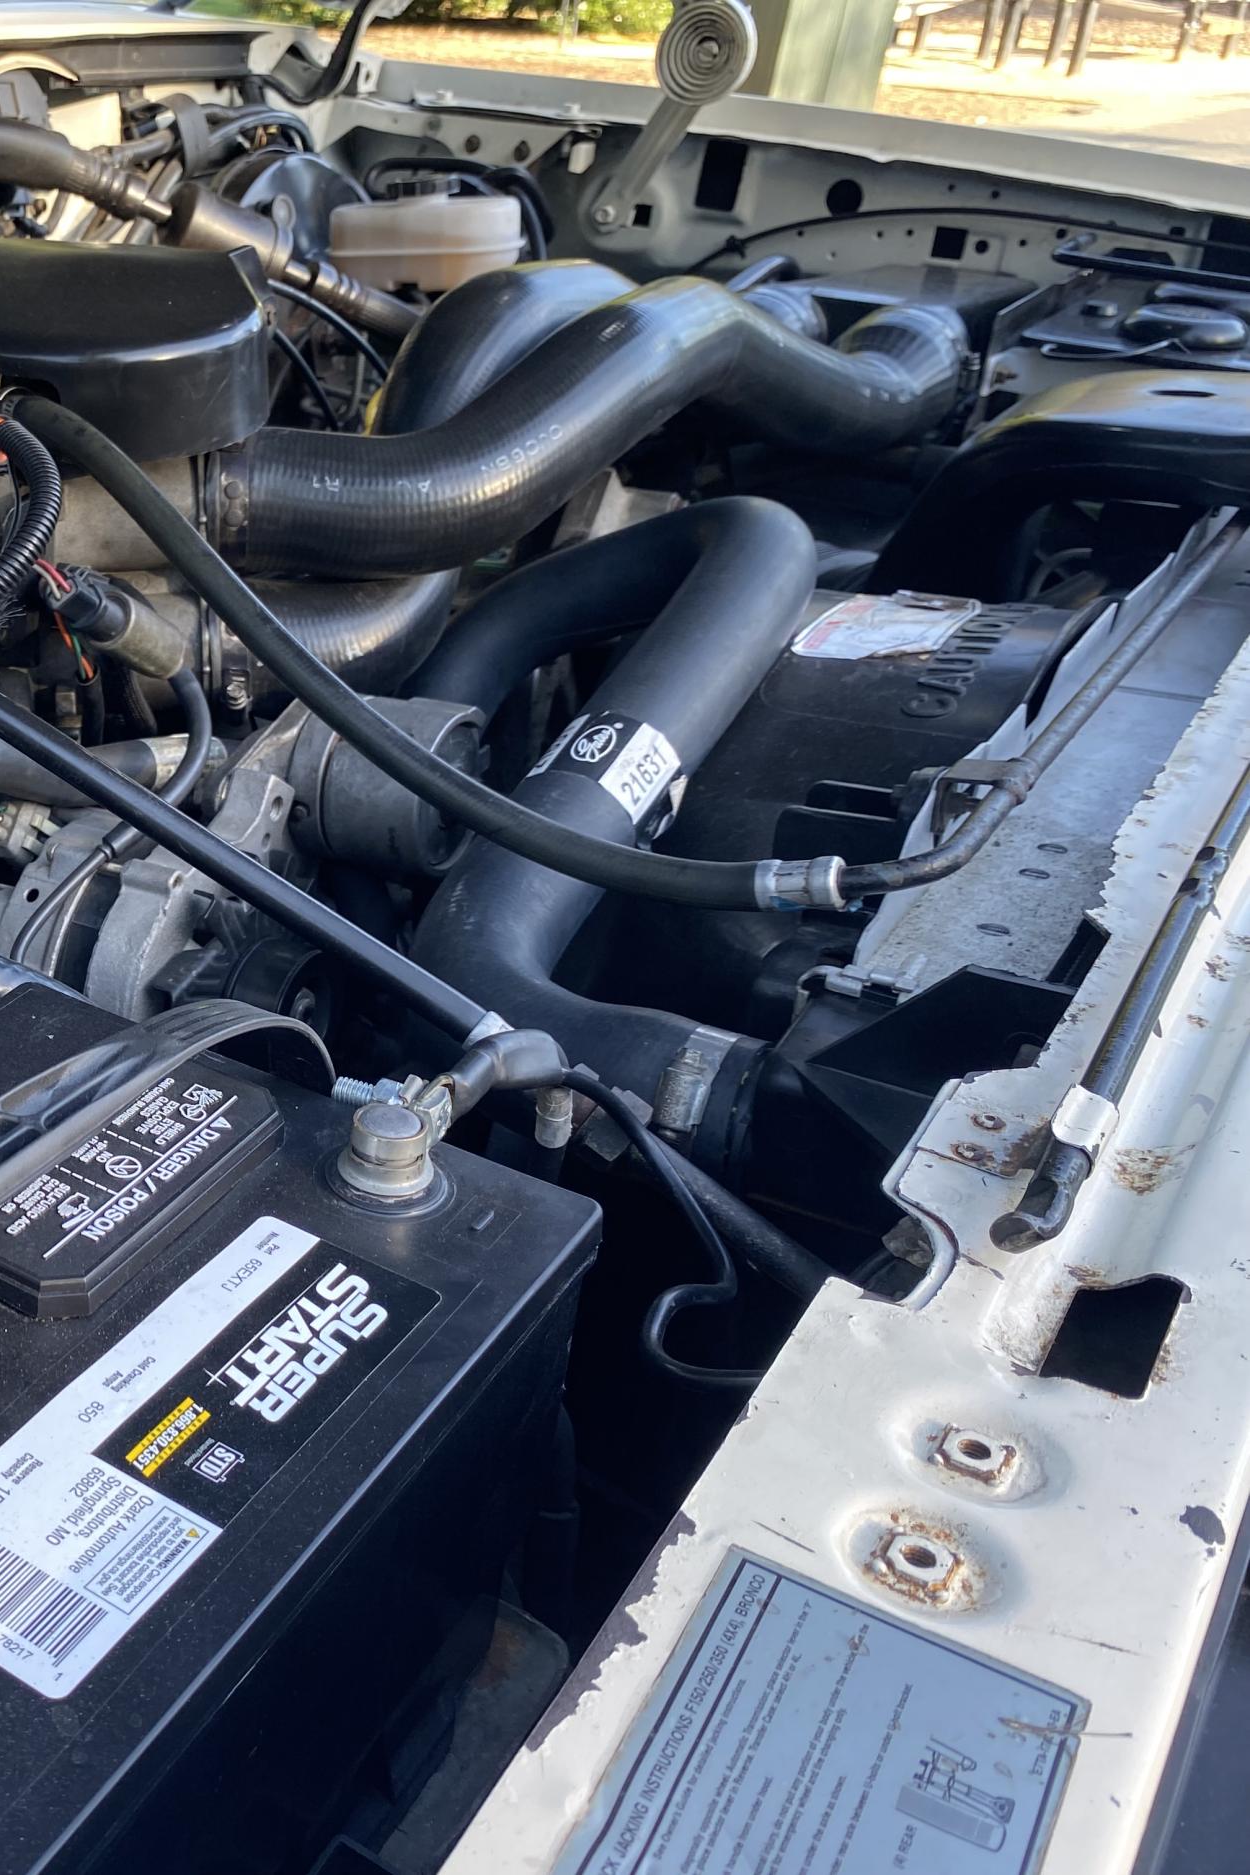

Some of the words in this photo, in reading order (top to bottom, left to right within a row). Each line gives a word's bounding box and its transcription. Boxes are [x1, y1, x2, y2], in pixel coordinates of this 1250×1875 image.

[620, 744, 668, 806] 21631
[135, 1101, 179, 1134] EXPLOSIVE
[140, 1096, 168, 1117] GASES
[150, 1118, 174, 1135] EYES
[155, 1123, 185, 1145] SHIELD
[96, 1151, 113, 1162] NO
[152, 1129, 219, 1180] DANGER
[27, 1183, 70, 1218] SULFURIC
[82, 1188, 148, 1240] POISON
[7, 1216, 30, 1235] ACID
[264, 1243, 280, 1255] Part
[221, 1259, 262, 1291] 65EXTJ
[225, 1262, 369, 1406] START
[137, 1356, 156, 1371] Cold
[251, 1293, 386, 1420] SUPER
[110, 1369, 142, 1392] Cranking
[78, 1401, 104, 1423] 850
[134, 1404, 202, 1469] 1.866.830.4351
[1, 1453, 34, 1479] Capacity
[12, 1459, 43, 1484] Reserve
[201, 1448, 235, 1476] STD
[69, 1467, 105, 1497] 65802
[62, 1476, 121, 1526] Springfield,
[74, 1486, 137, 1537] Distributors,
[120, 1495, 153, 1522] Ozark
[46, 1525, 70, 1545] MO
[69, 1521, 126, 1573] Automotive
[136, 1528, 170, 1561] reproductive
[171, 1526, 185, 1539] you
[156, 1539, 190, 1569] WARNING:
[101, 1583, 117, 1596] See
[116, 1564, 149, 1596] carcinogen
[144, 1569, 160, 1582] Can
[123, 1581, 147, 1603] expose
[614, 1802, 648, 1857] JACKING
[641, 1715, 692, 1801] INSTRUCTIONS
[685, 1645, 728, 1713] F150/250/350
[735, 1575, 765, 1617] BRONCO
[653, 1843, 666, 1860] See
[676, 1787, 693, 1810] Guide
[687, 1774, 698, 1785] for
[694, 1744, 713, 1774] detailed
[709, 1718, 727, 1745] jacking
